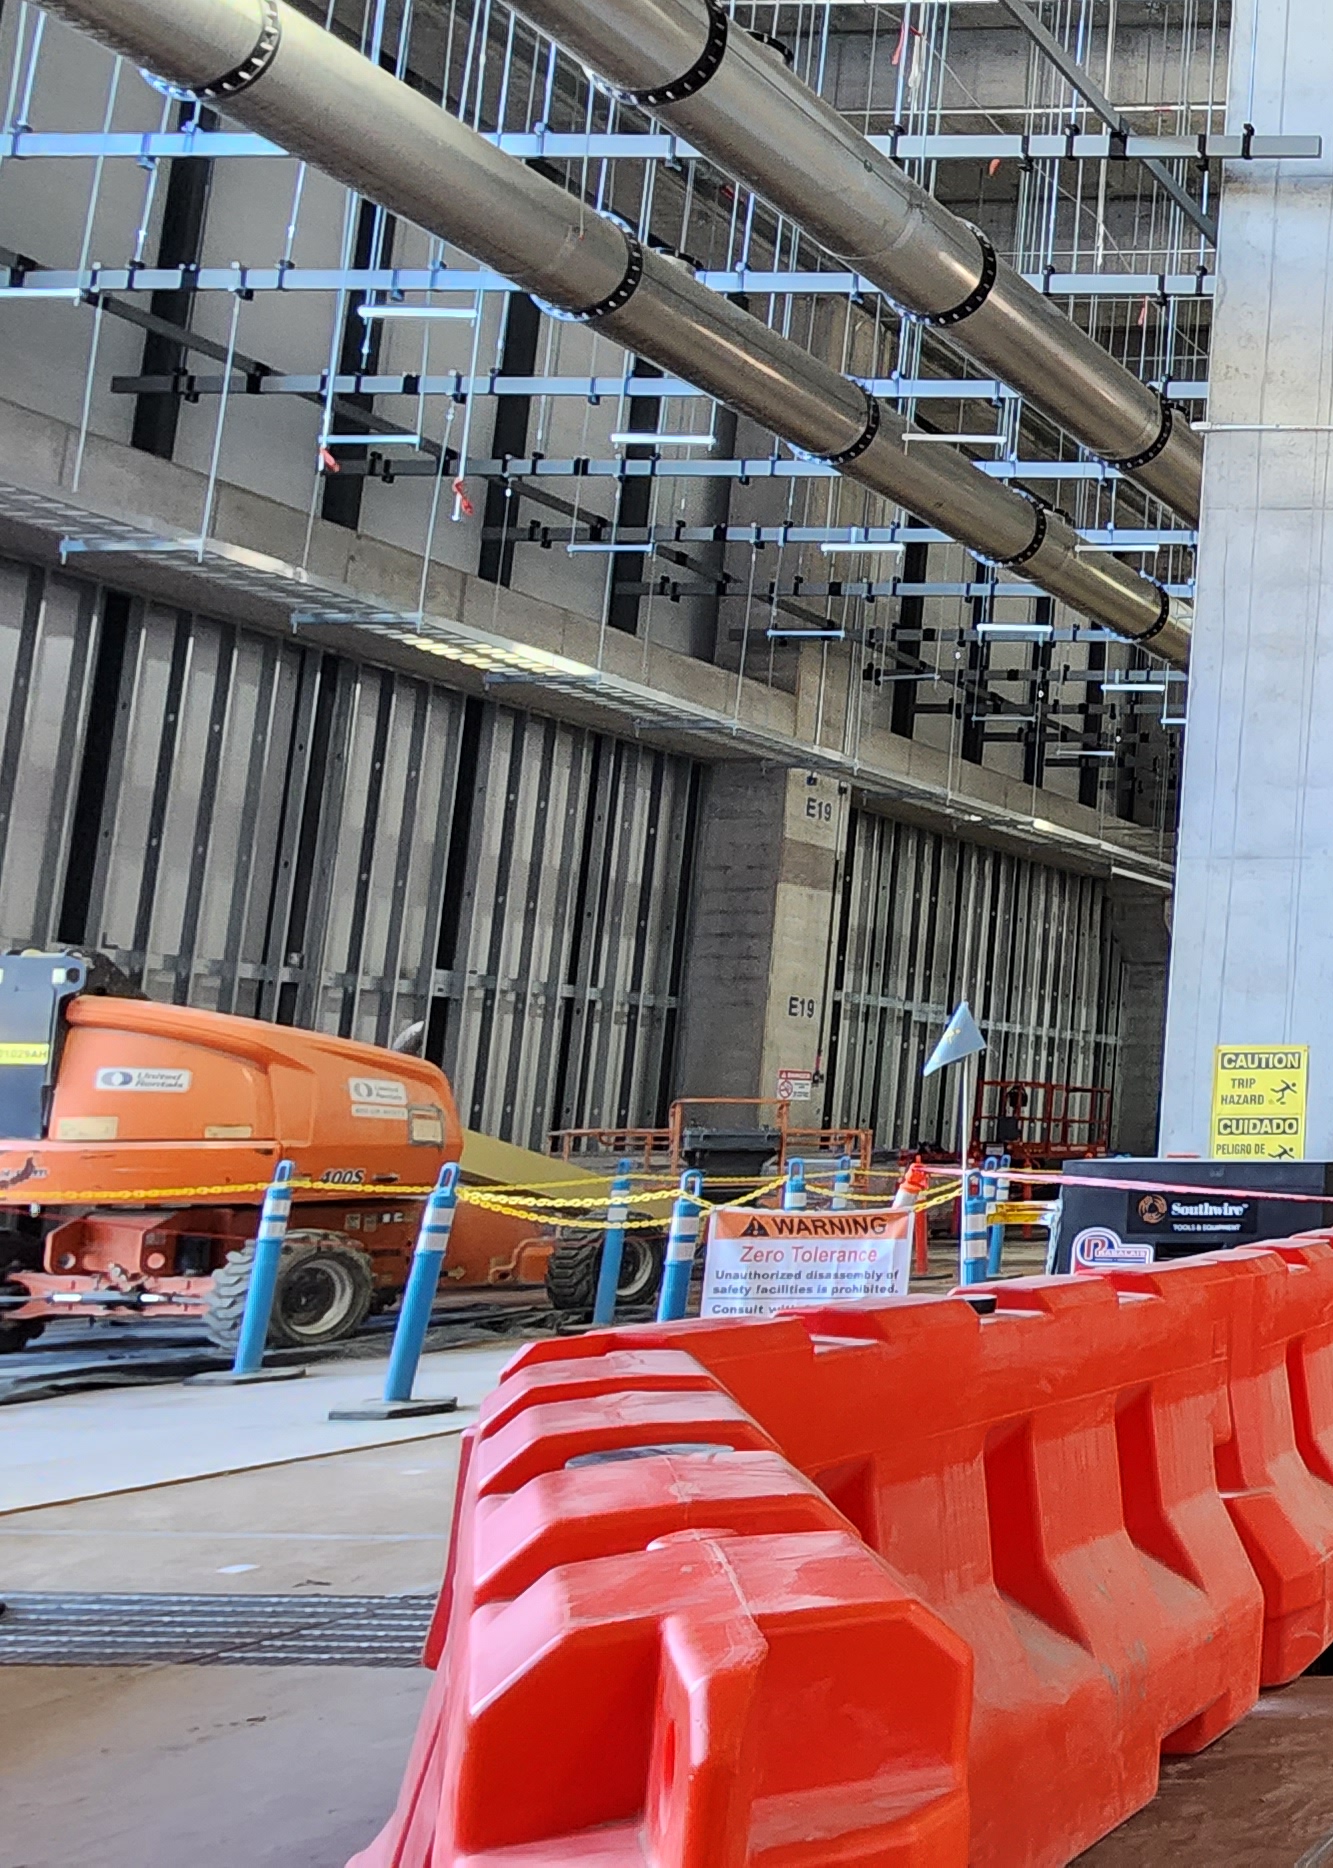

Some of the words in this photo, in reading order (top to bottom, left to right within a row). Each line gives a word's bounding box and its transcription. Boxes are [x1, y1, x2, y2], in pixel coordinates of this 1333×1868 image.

[806, 797, 832, 821] E19
[788, 997, 815, 1018] E19
[1223, 1053, 1300, 1069] CAUTION
[1231, 1078, 1256, 1089] TRIP
[1220, 1094, 1265, 1105] HAZARD
[1219, 1119, 1298, 1135] CUIDADO
[1216, 1143, 1252, 1155] PELIGRO
[1254, 1143, 1266, 1155] DE
[771, 1216, 888, 1236] WARNING
[739, 1246, 785, 1263] Zero
[791, 1246, 878, 1263] Tolerance
[715, 1270, 801, 1280] Unauthorized
[805, 1270, 883, 1282] disassembly
[886, 1269, 900, 1280] of
[713, 1285, 756, 1297] safety
[756, 1285, 813, 1294] facilities
[816, 1285, 828, 1294] is
[831, 1284, 899, 1297] prohibited.
[712, 1304, 764, 1314] Consult
